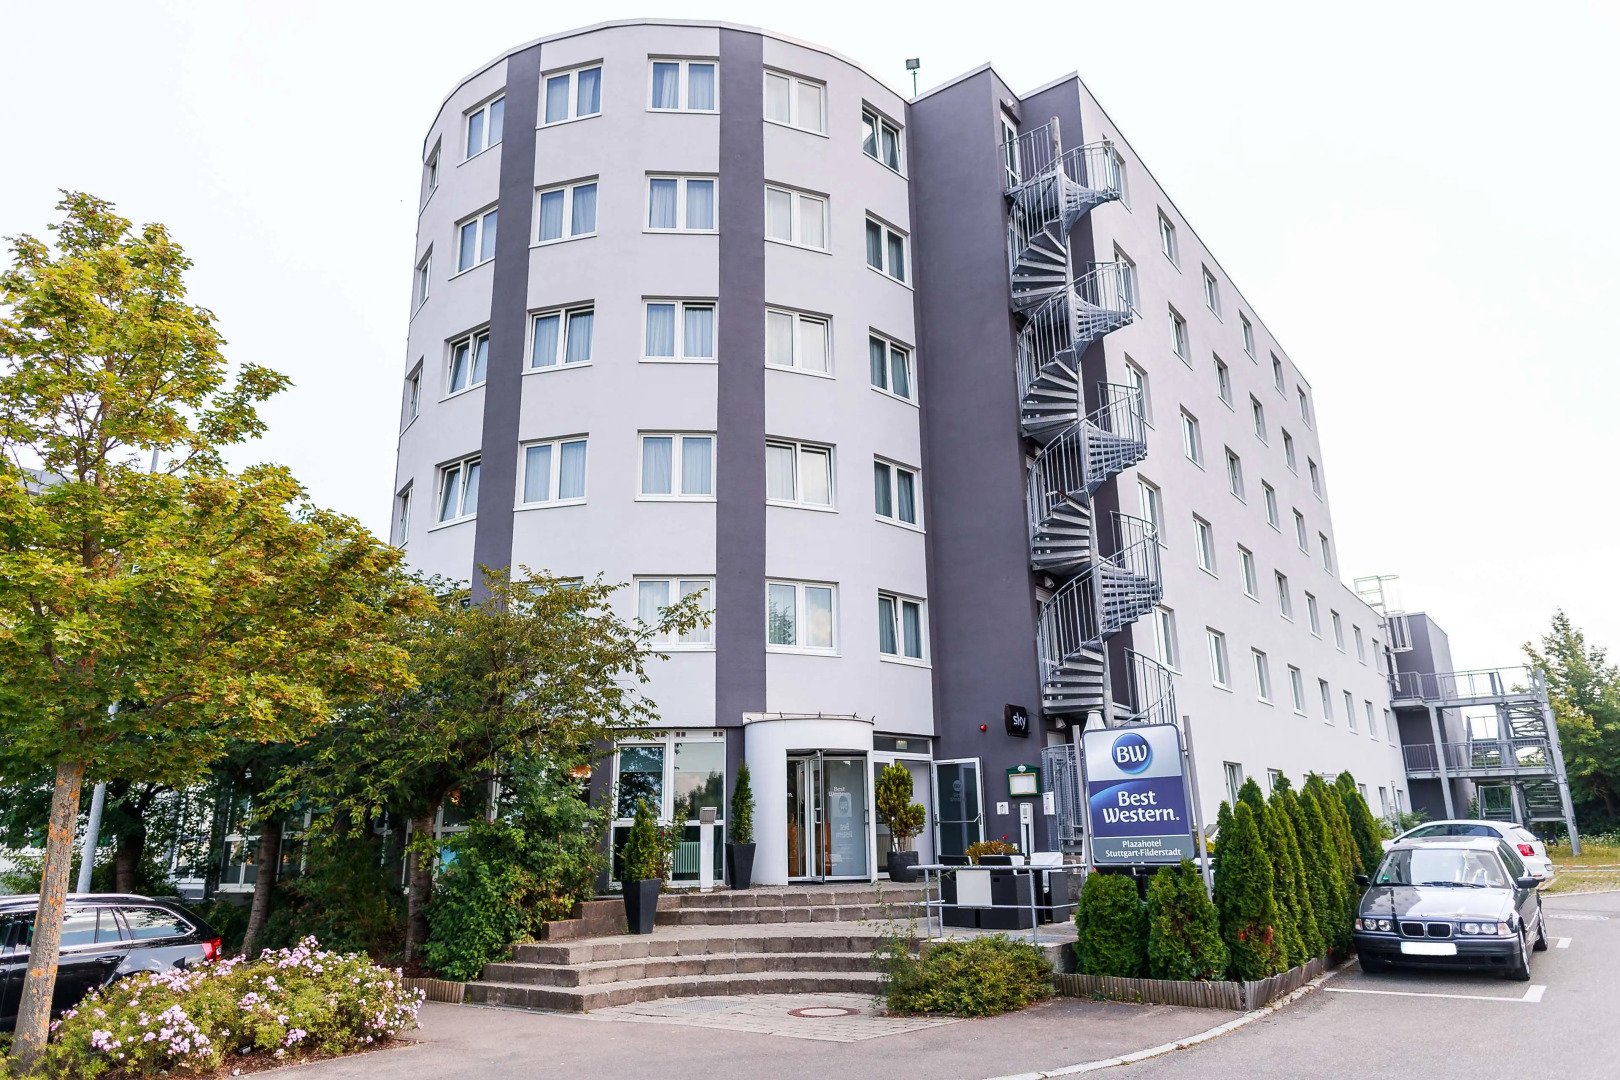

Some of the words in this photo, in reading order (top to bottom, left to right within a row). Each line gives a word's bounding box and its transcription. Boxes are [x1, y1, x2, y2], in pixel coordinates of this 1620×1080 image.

[1013, 712, 1026, 730] sky
[1116, 745, 1147, 763] BW
[1118, 791, 1157, 806] Best
[1122, 840, 1161, 848] Plazahotel
[1105, 848, 1181, 858] Stuttgart-Filderstadt
